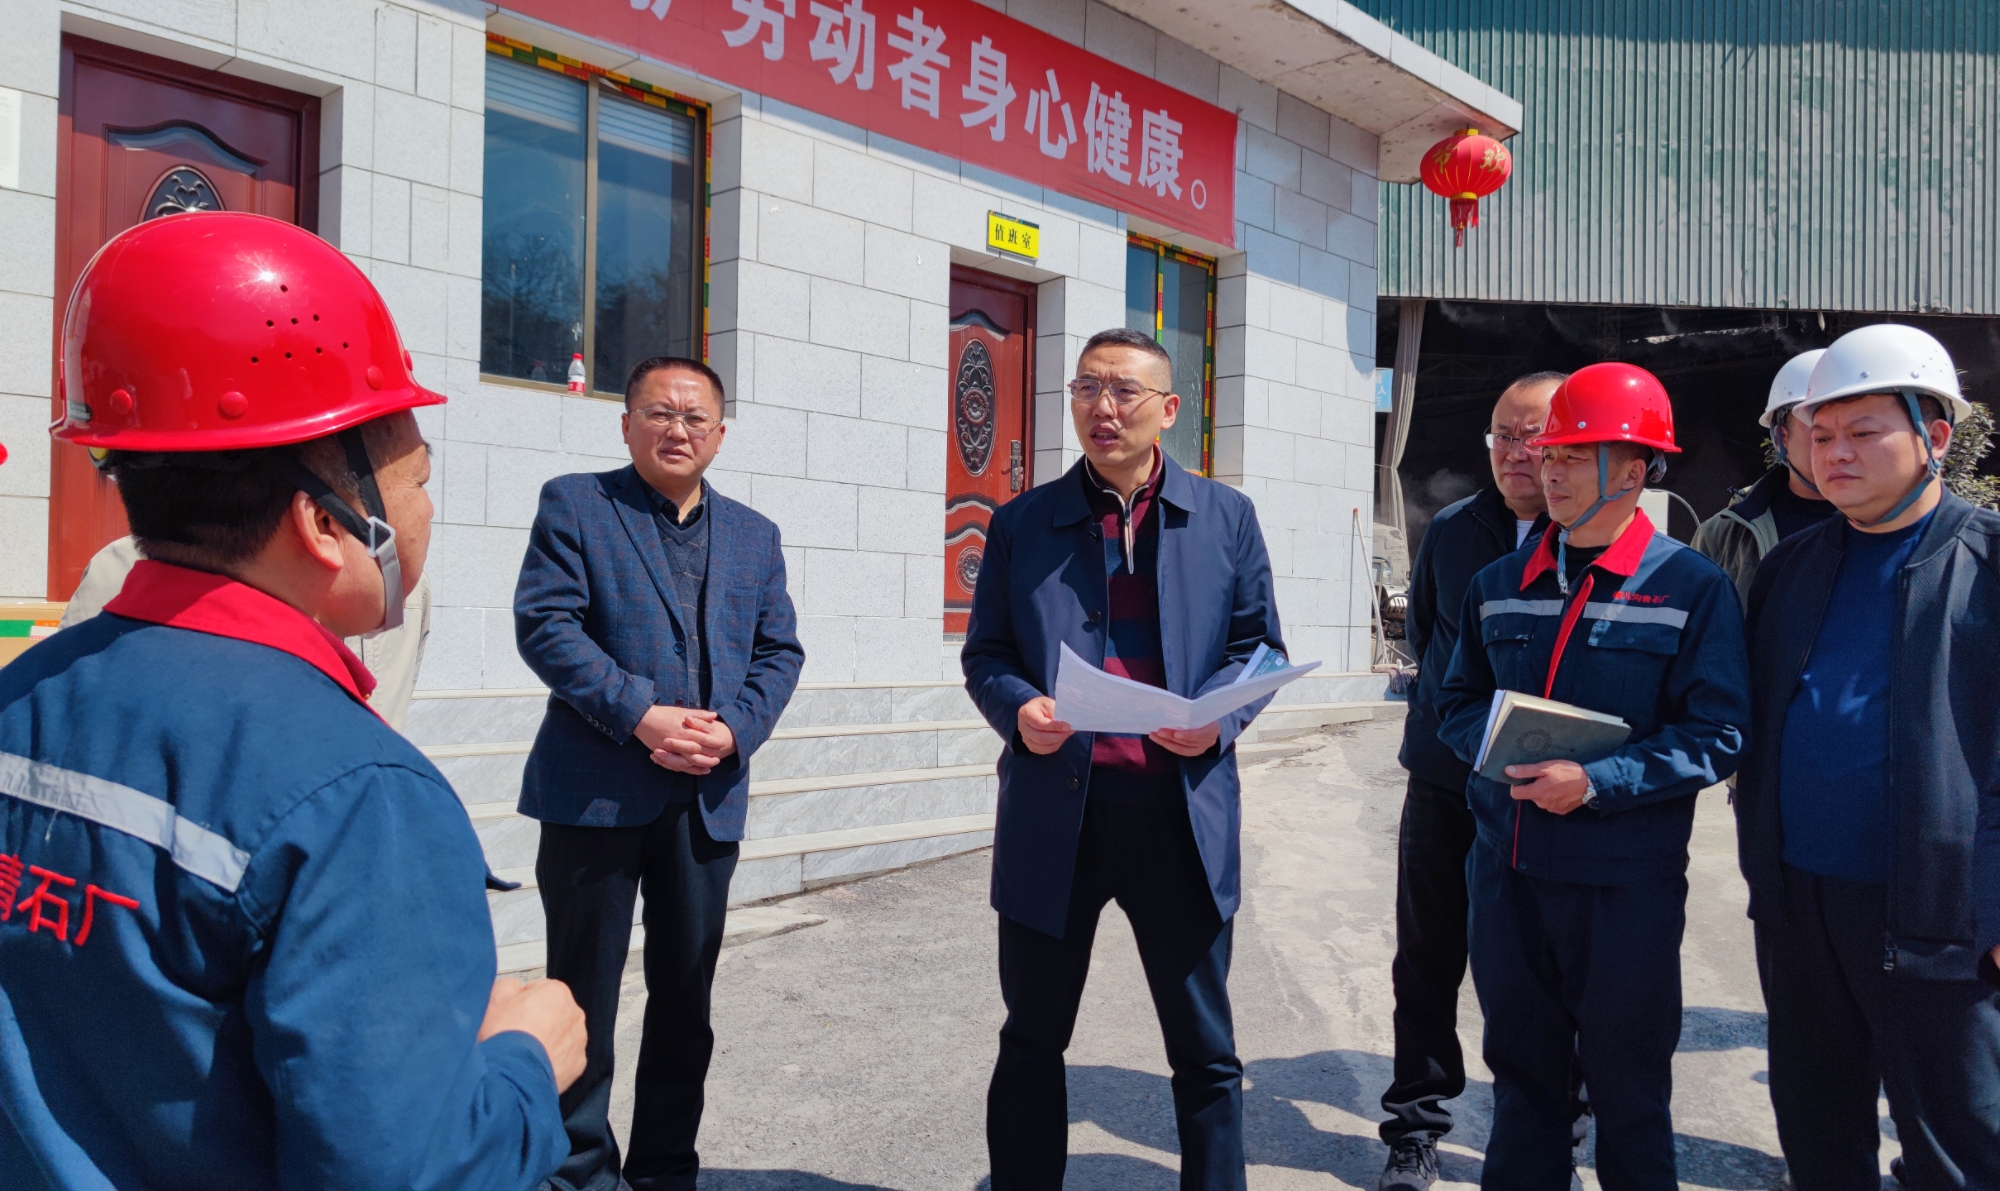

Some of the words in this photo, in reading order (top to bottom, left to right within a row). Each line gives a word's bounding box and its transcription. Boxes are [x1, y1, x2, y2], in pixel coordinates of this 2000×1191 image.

[630, 0, 1206, 210] 劳动者身心健康。
[995, 223, 1031, 249] 值班室
